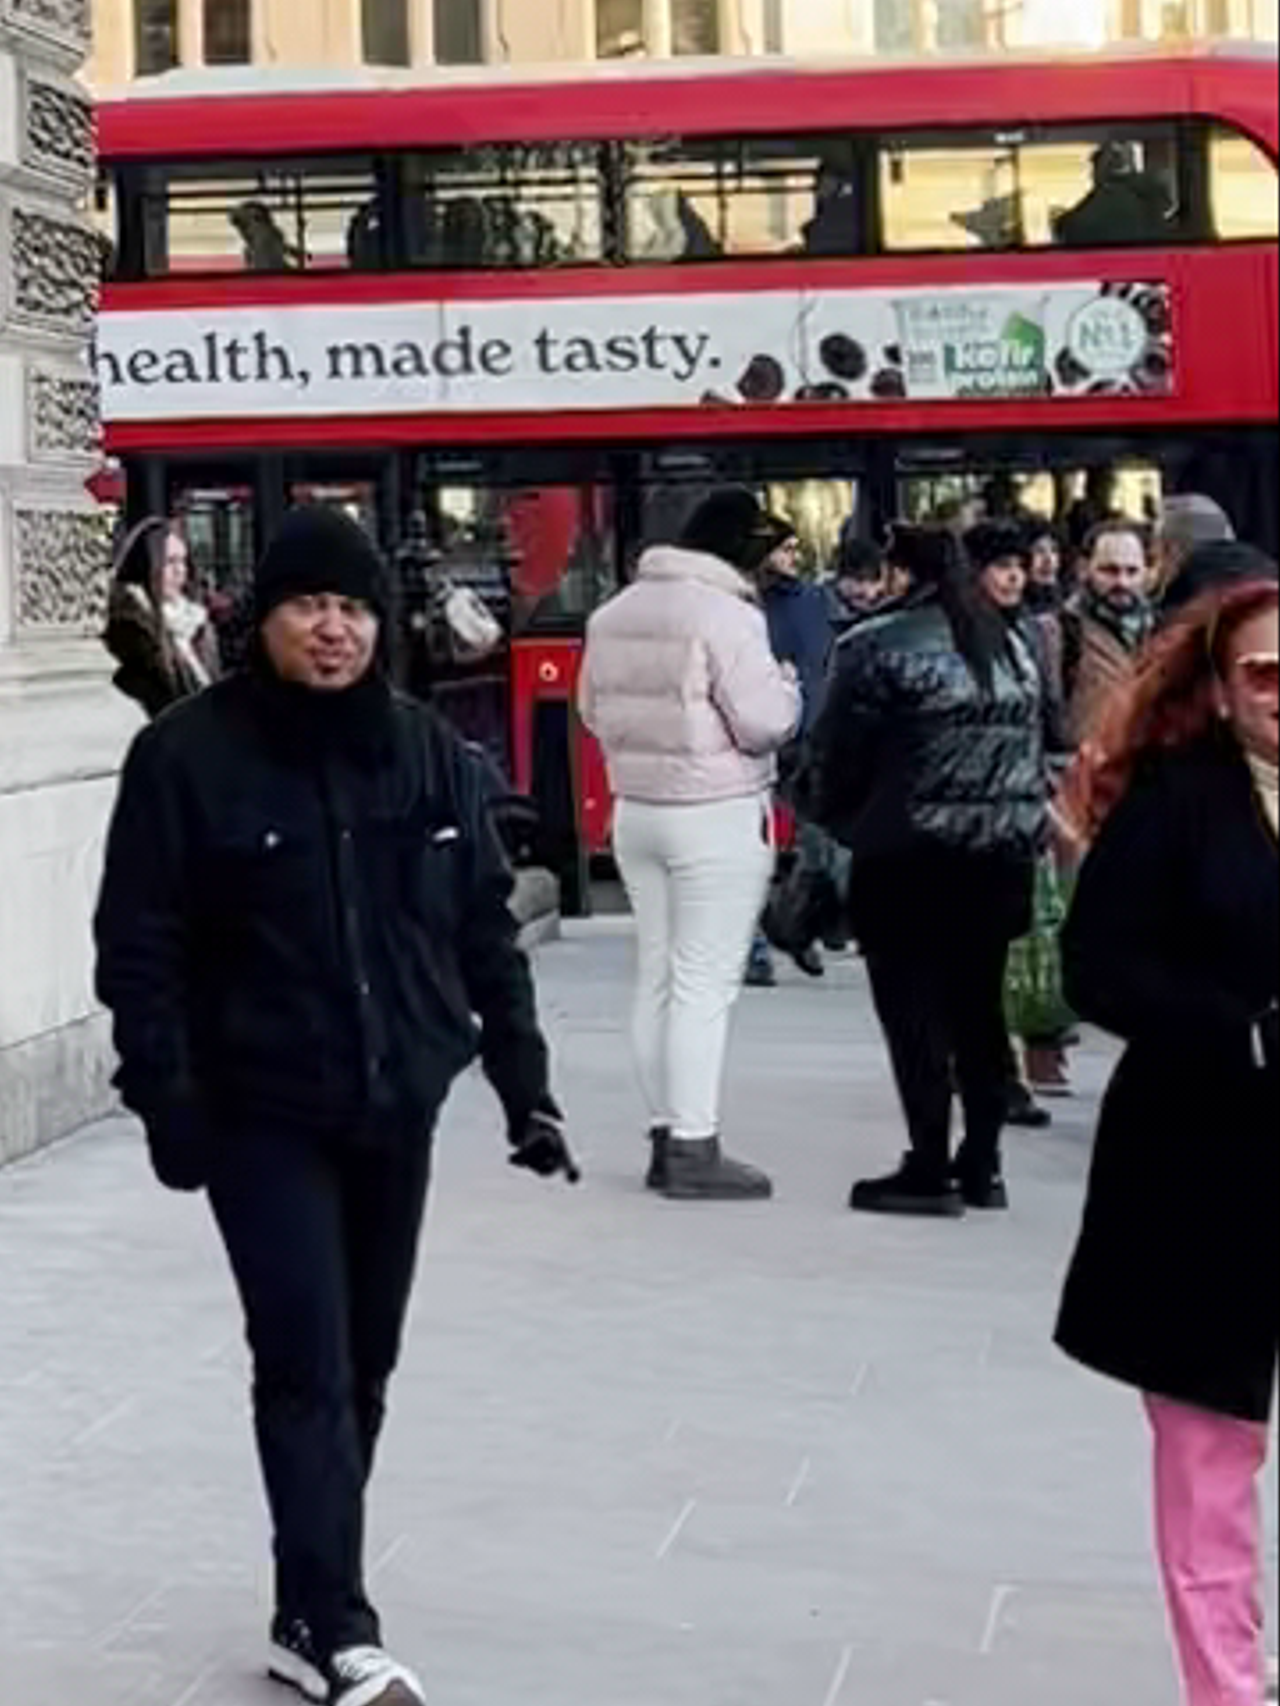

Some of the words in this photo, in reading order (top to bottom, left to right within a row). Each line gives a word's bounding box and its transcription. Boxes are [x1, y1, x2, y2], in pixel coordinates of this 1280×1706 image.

[88, 330, 311, 386] health,
[326, 324, 512, 379] made
[534, 325, 723, 382] tasty.
